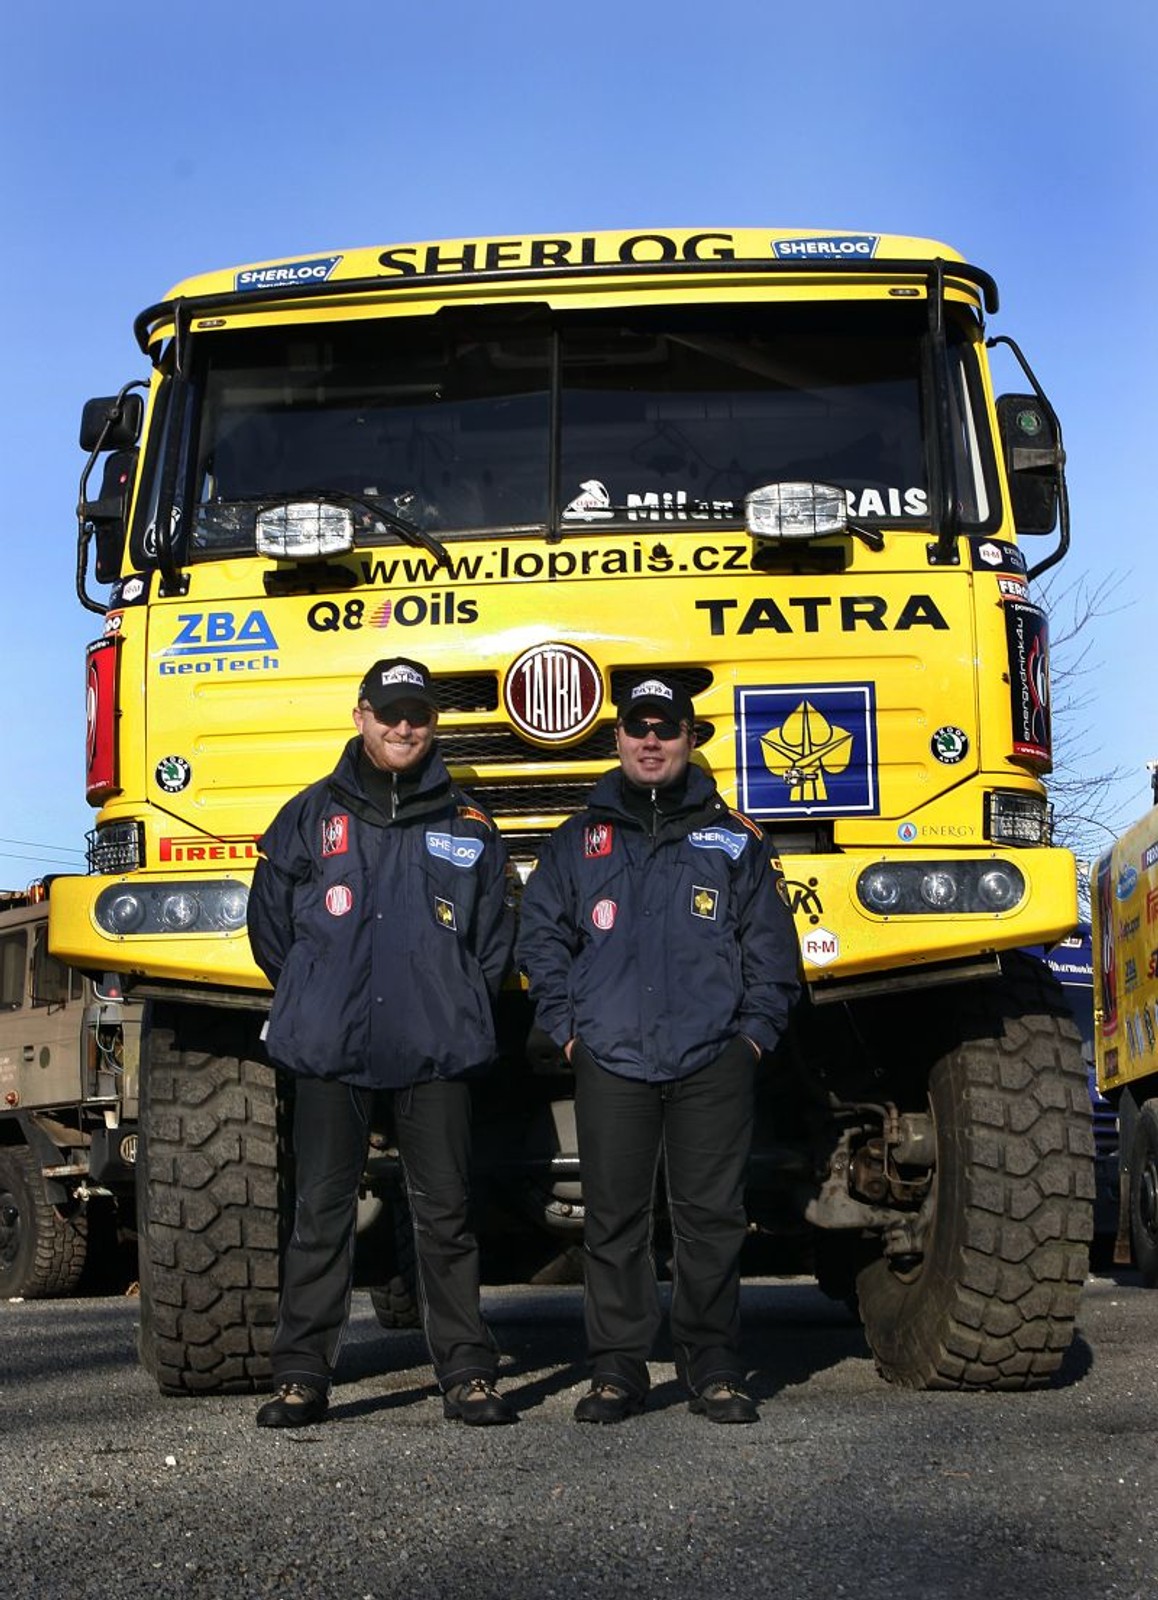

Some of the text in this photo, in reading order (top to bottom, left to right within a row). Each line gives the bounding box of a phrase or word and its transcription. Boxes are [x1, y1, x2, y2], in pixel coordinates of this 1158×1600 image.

[377, 233, 735, 278] SHERLOG
[779, 242, 870, 254] SHERLOG
[240, 266, 327, 284] SHERLOG
[846, 487, 928, 517] RAIS
[361, 542, 748, 584] www.loprais.cz
[307, 591, 479, 632] Q8 Oils
[696, 594, 949, 635] TATRA
[162, 610, 279, 656] ZBA
[159, 656, 279, 676] GeoTech
[521, 651, 583, 731] TATRA
[922, 825, 975, 837] ENERGY
[160, 835, 260, 862] PIRELL
[430, 837, 476, 860] SHELOG
[807, 941, 835, 953] R-M
